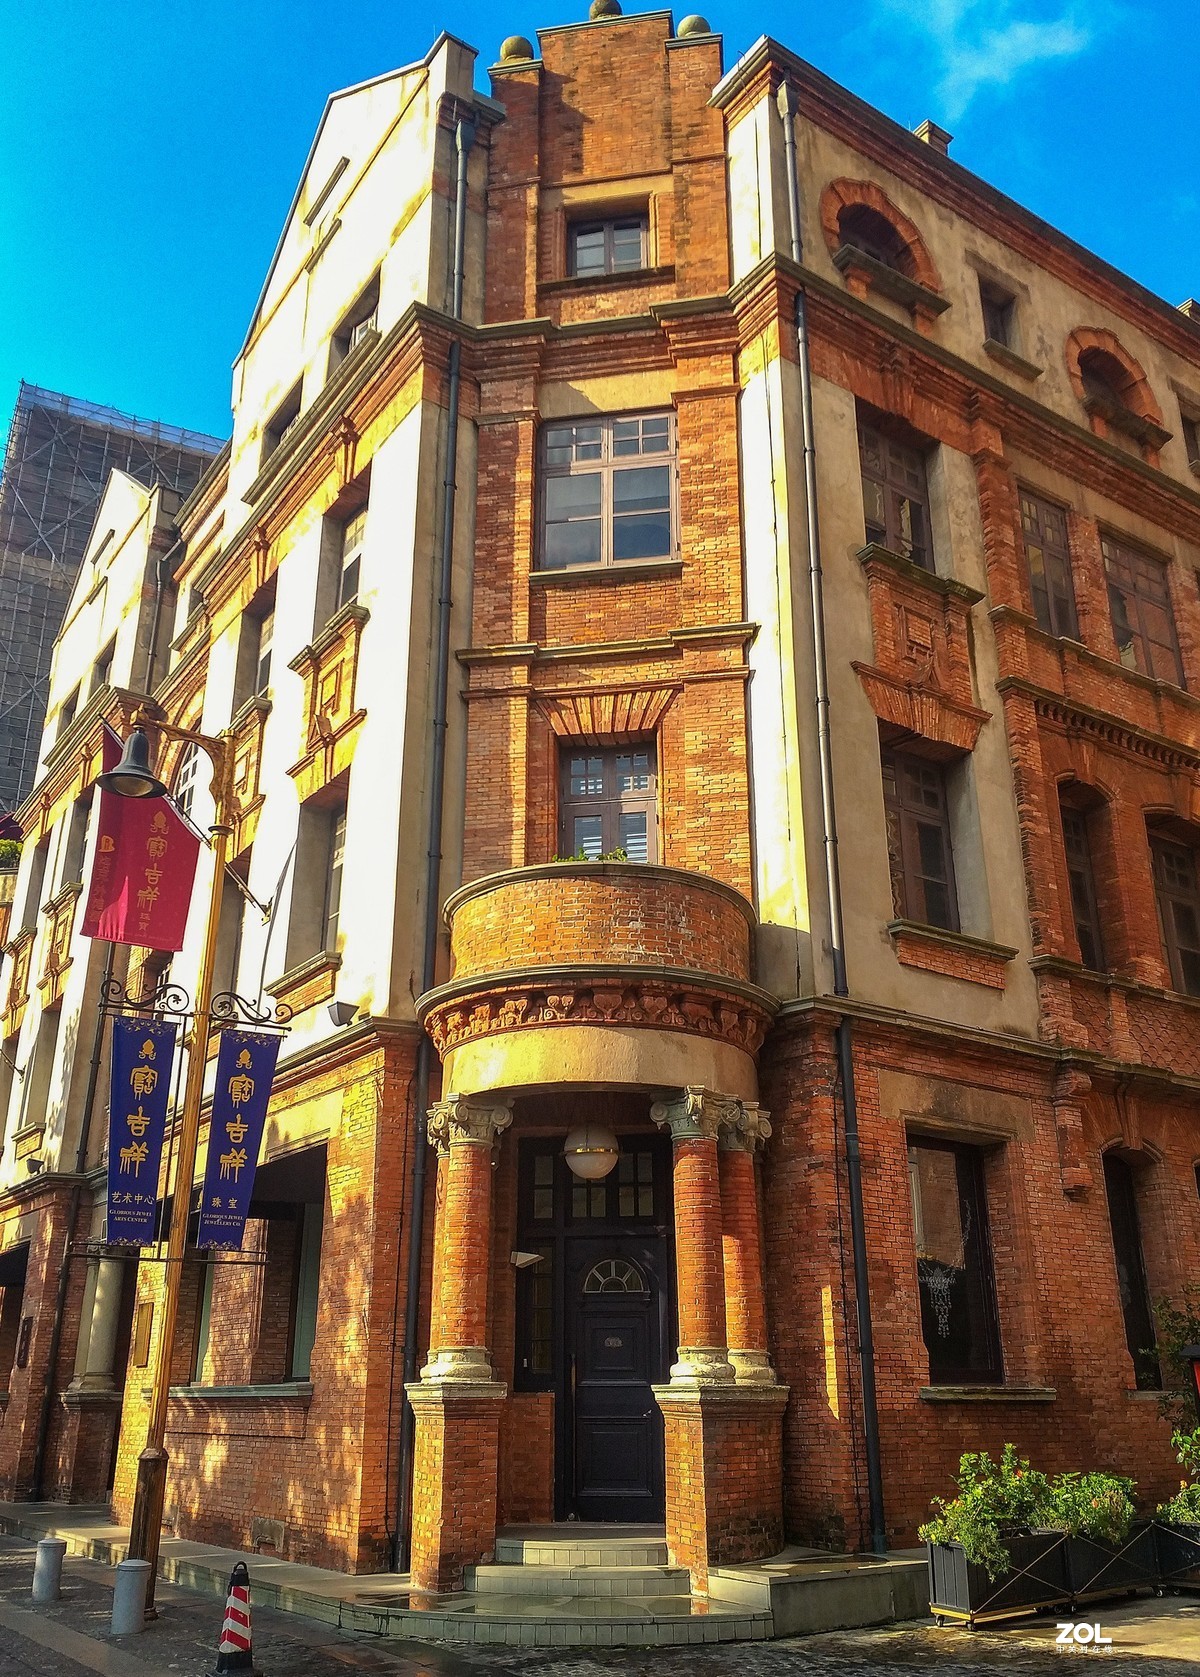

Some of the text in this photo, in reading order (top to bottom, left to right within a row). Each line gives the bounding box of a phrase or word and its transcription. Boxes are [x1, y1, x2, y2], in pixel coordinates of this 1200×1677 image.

[111, 1191, 155, 1205] 艺术中心
[211, 1196, 238, 1209] 珠宝
